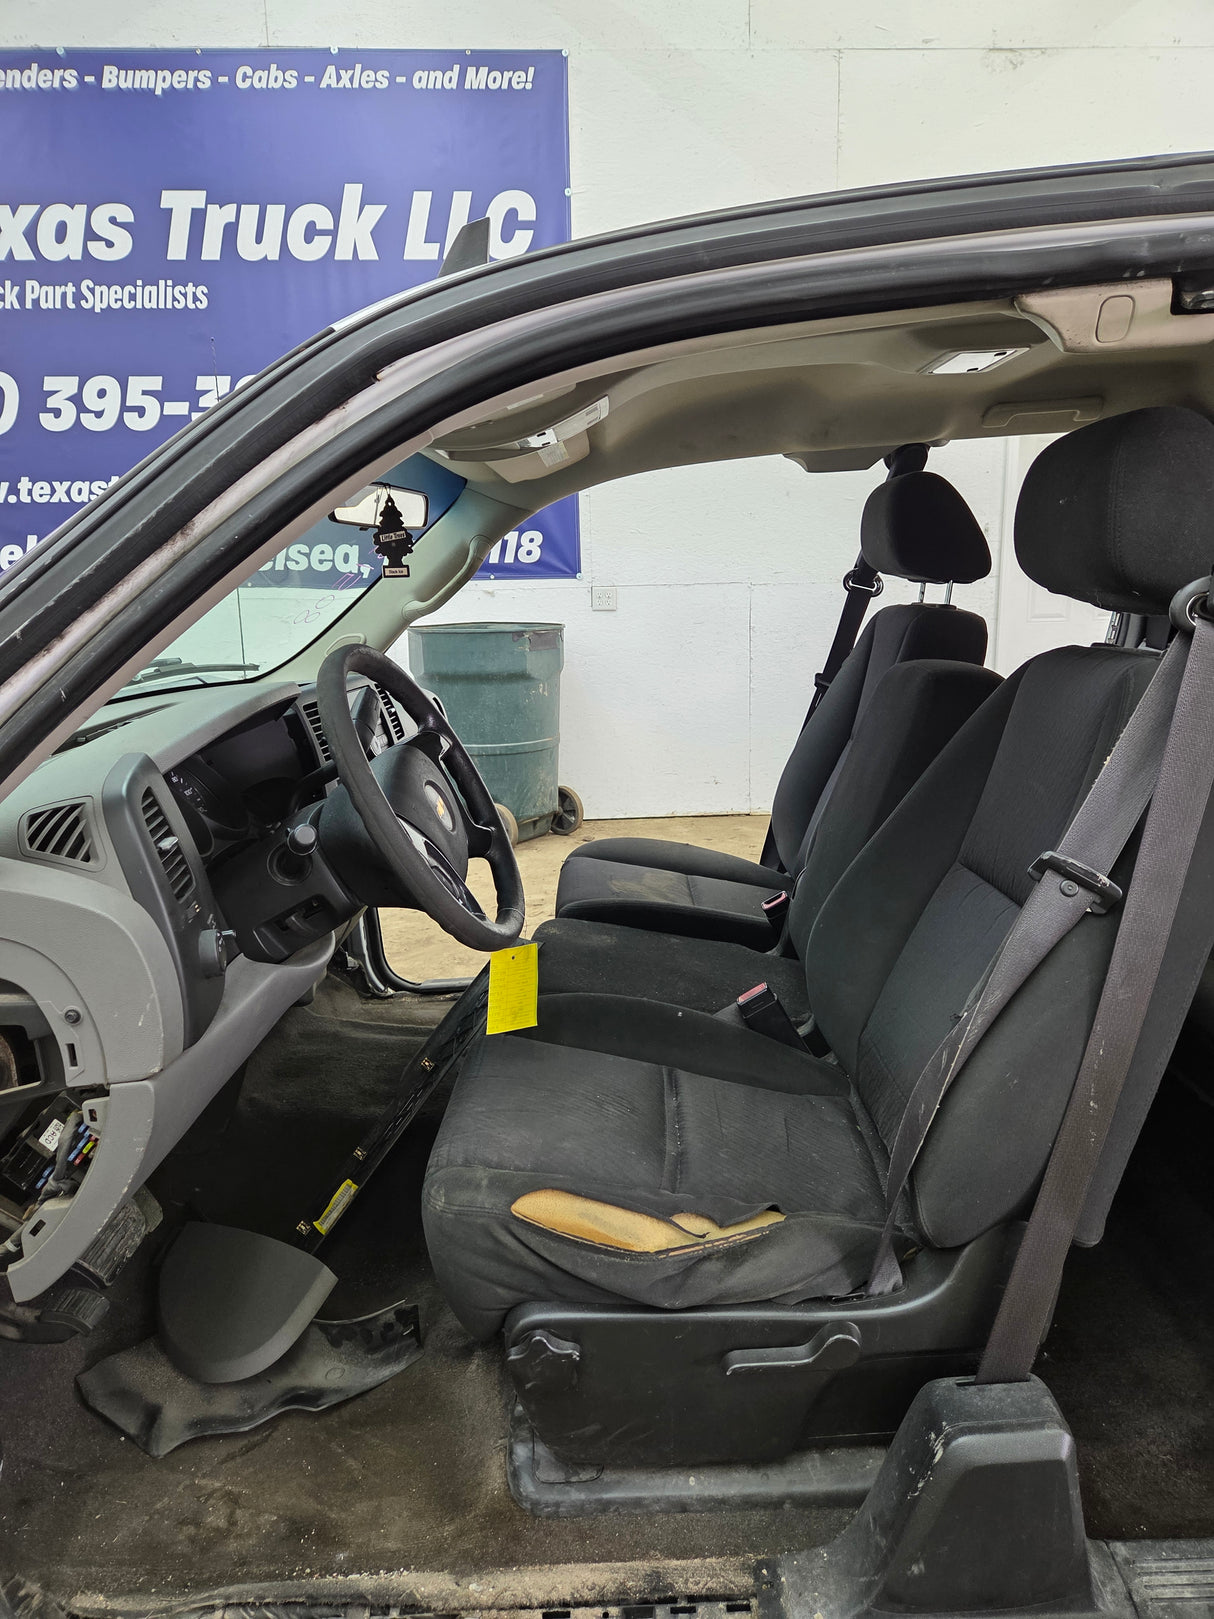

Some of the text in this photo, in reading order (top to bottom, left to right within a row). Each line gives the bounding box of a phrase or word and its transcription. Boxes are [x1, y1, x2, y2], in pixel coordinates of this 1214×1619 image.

[102, 65, 212, 95] Bumpers
[235, 64, 298, 89] Cabs
[320, 64, 390, 89] Axles
[412, 64, 460, 90] and
[464, 66, 535, 90] More!
[0, 183, 537, 263] xas Truck LLC
[25, 279, 76, 310] Part
[80, 279, 209, 313] Specialists
[38, 375, 257, 432] 395-3
